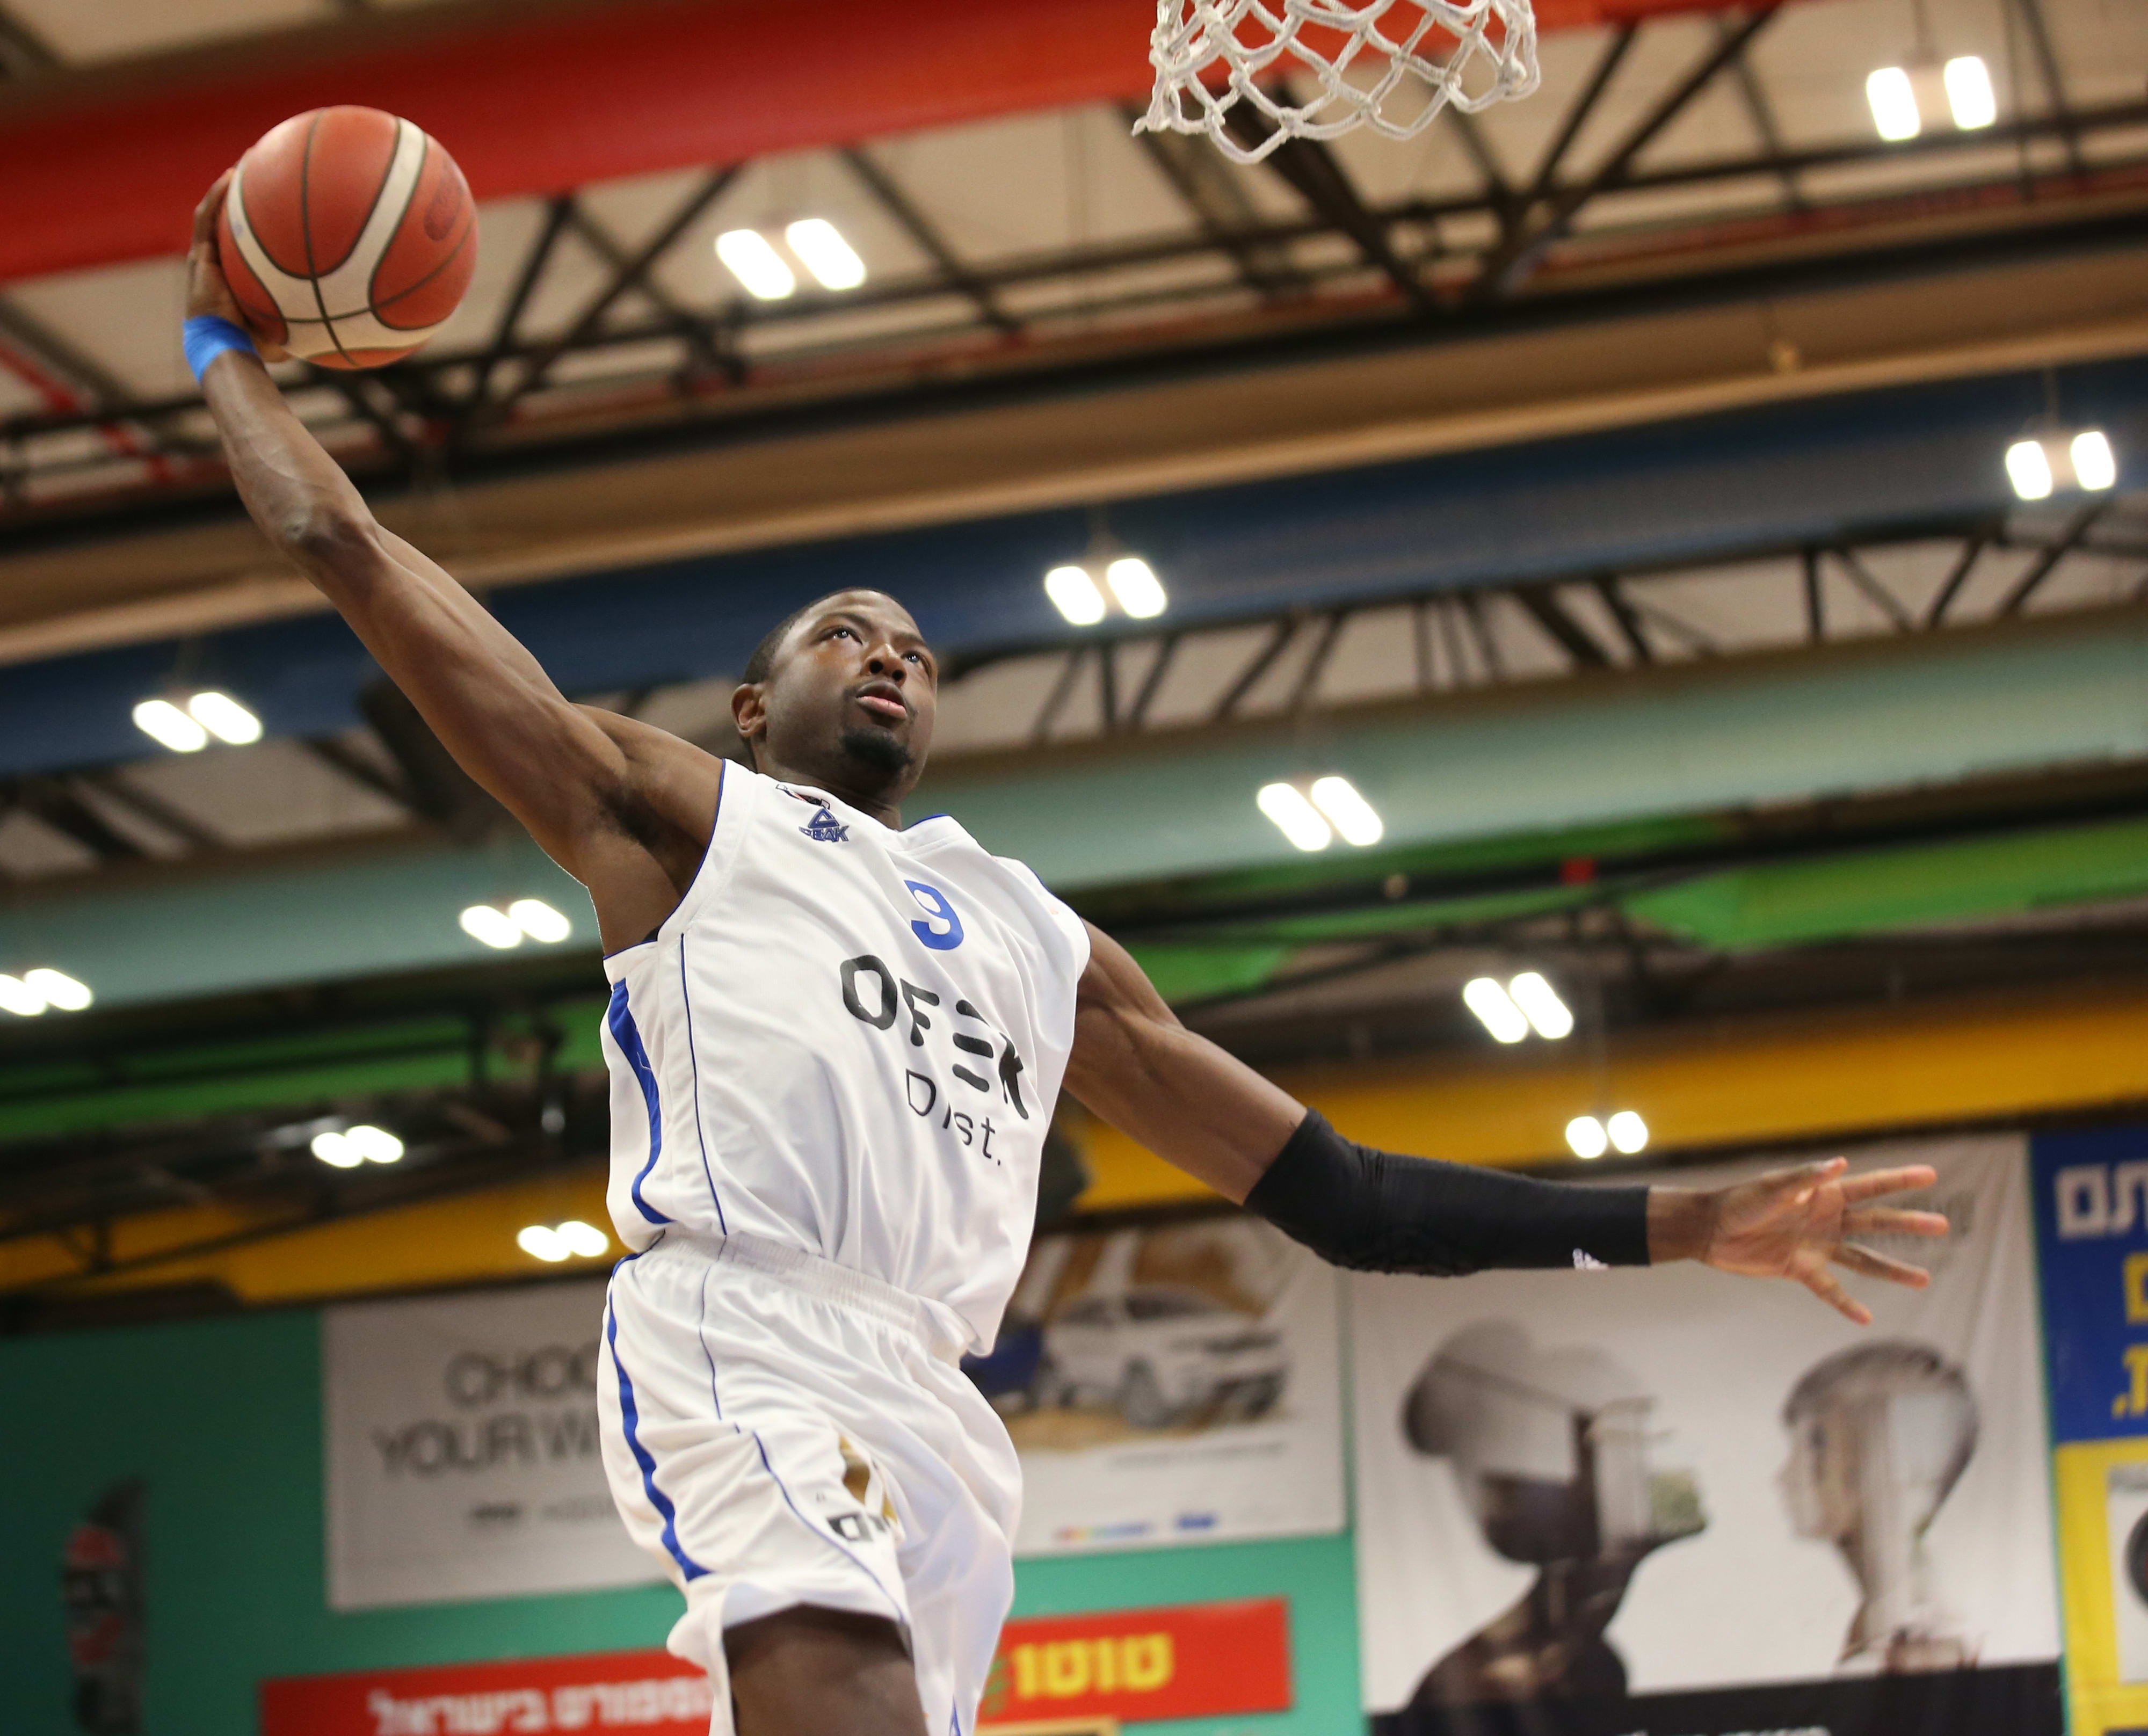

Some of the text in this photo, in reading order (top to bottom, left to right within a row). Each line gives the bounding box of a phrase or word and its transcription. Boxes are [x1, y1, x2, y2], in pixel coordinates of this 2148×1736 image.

[904, 880, 964, 950] 9
[840, 955, 1029, 1120] OFEK
[372, 1413, 534, 1474] YOUR
